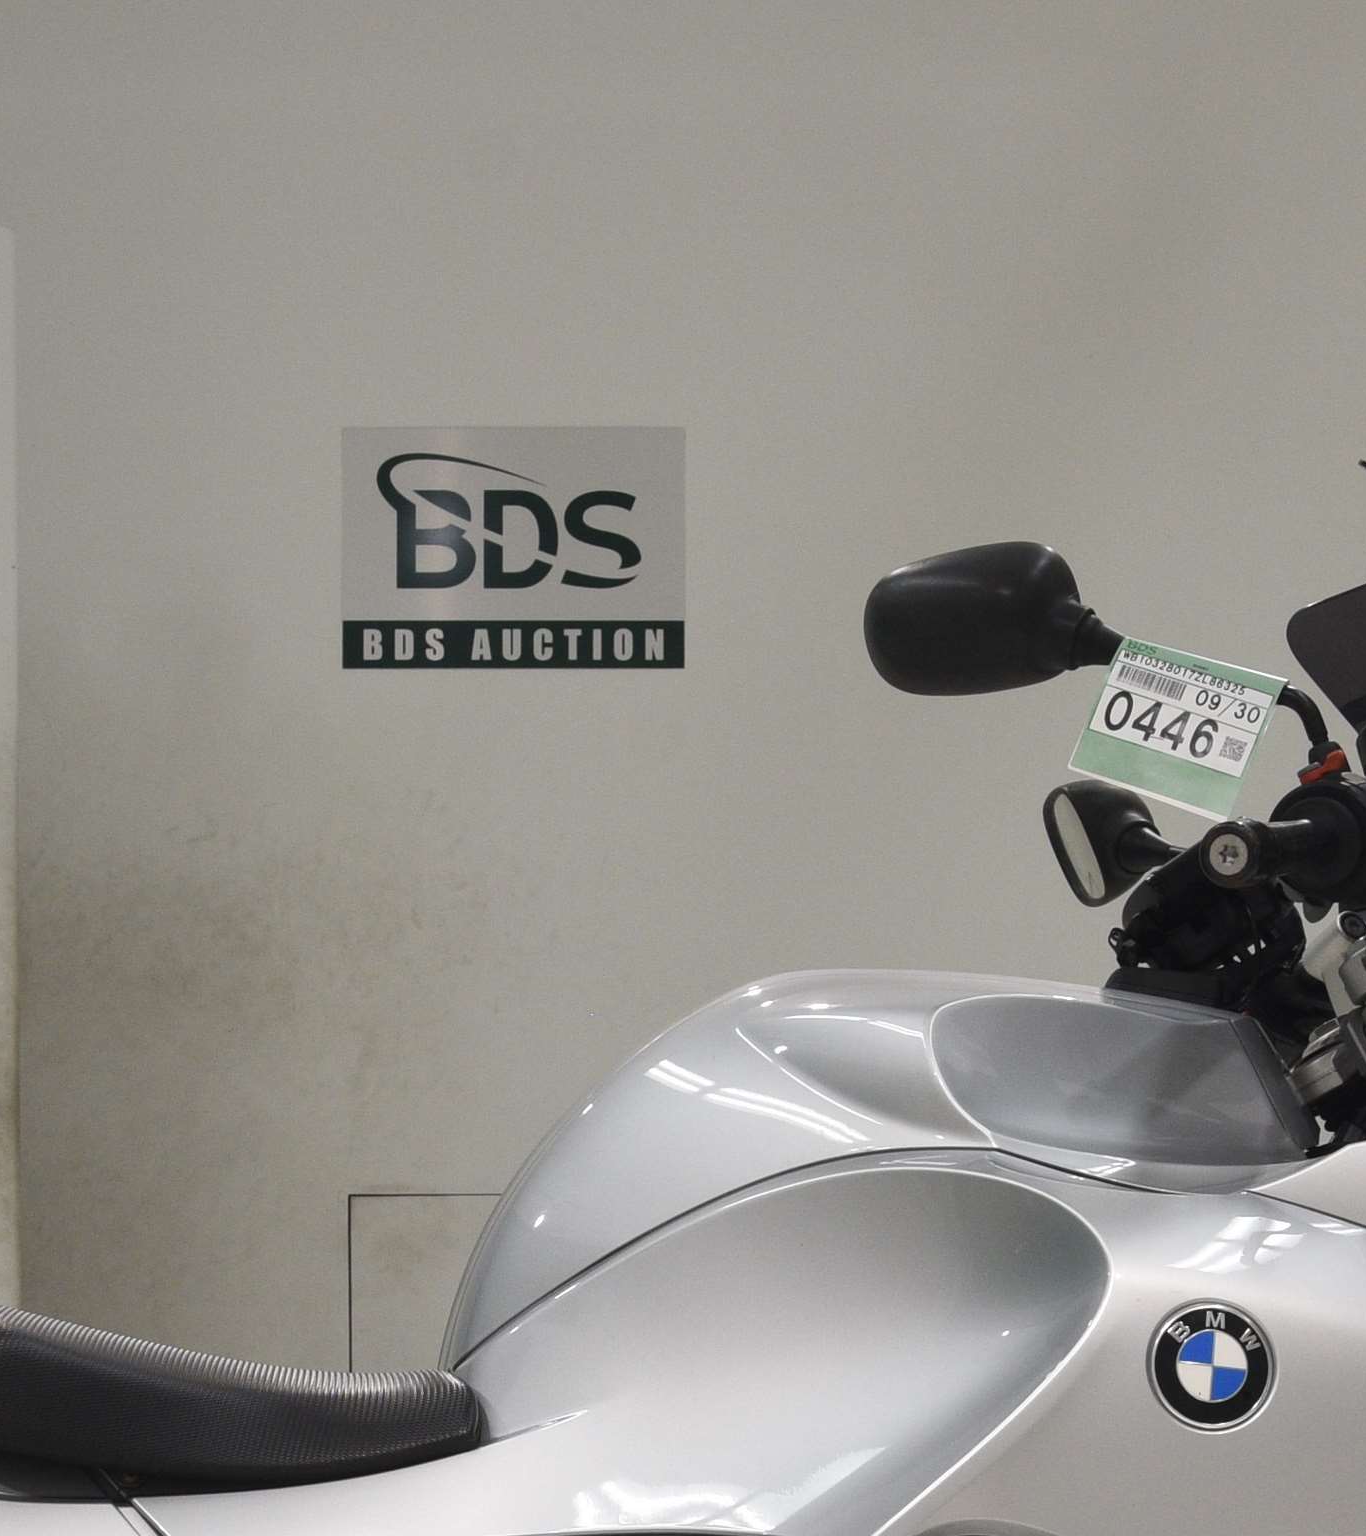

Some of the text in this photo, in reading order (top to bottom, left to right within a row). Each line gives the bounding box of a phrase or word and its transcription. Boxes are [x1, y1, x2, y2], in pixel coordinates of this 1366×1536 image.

[377, 453, 642, 589] BDS
[362, 627, 666, 662] BDS AUCTION
[1104, 690, 1219, 758] 0446
[1195, 689, 1261, 724] 09/30
[1167, 1310, 1262, 1352] BMW
